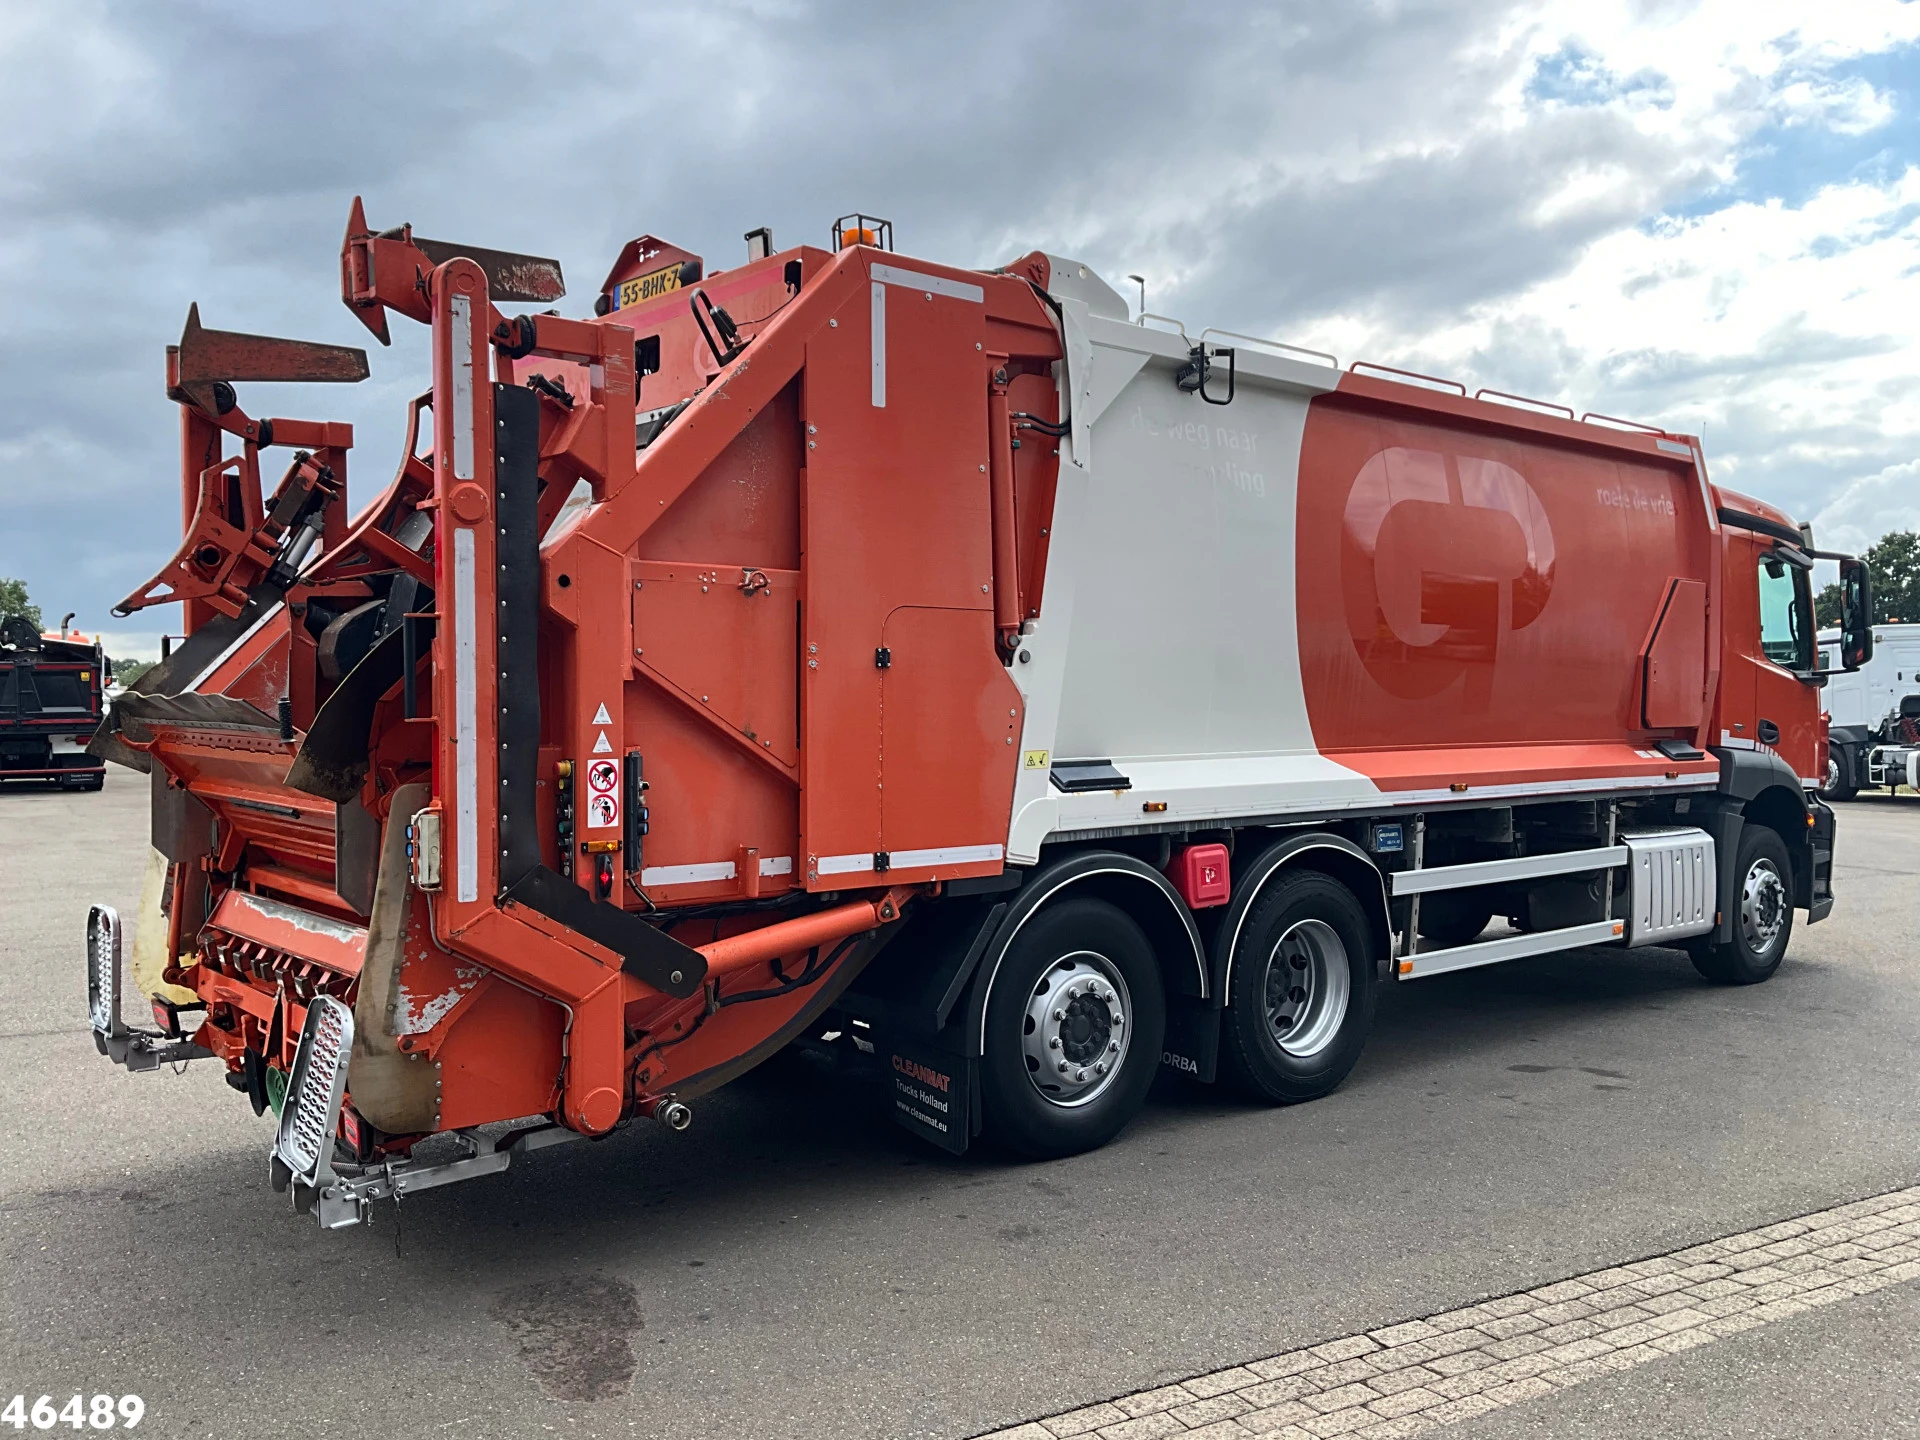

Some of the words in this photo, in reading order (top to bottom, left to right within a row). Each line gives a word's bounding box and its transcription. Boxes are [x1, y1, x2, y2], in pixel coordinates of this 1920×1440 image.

[622, 268, 679, 306] 55-BHK-7
[892, 1054, 950, 1093] CLEANMAT
[896, 1078, 919, 1099] Trucks
[919, 1089, 948, 1113] Holland
[896, 1099, 947, 1133] www.cleanmat.eu
